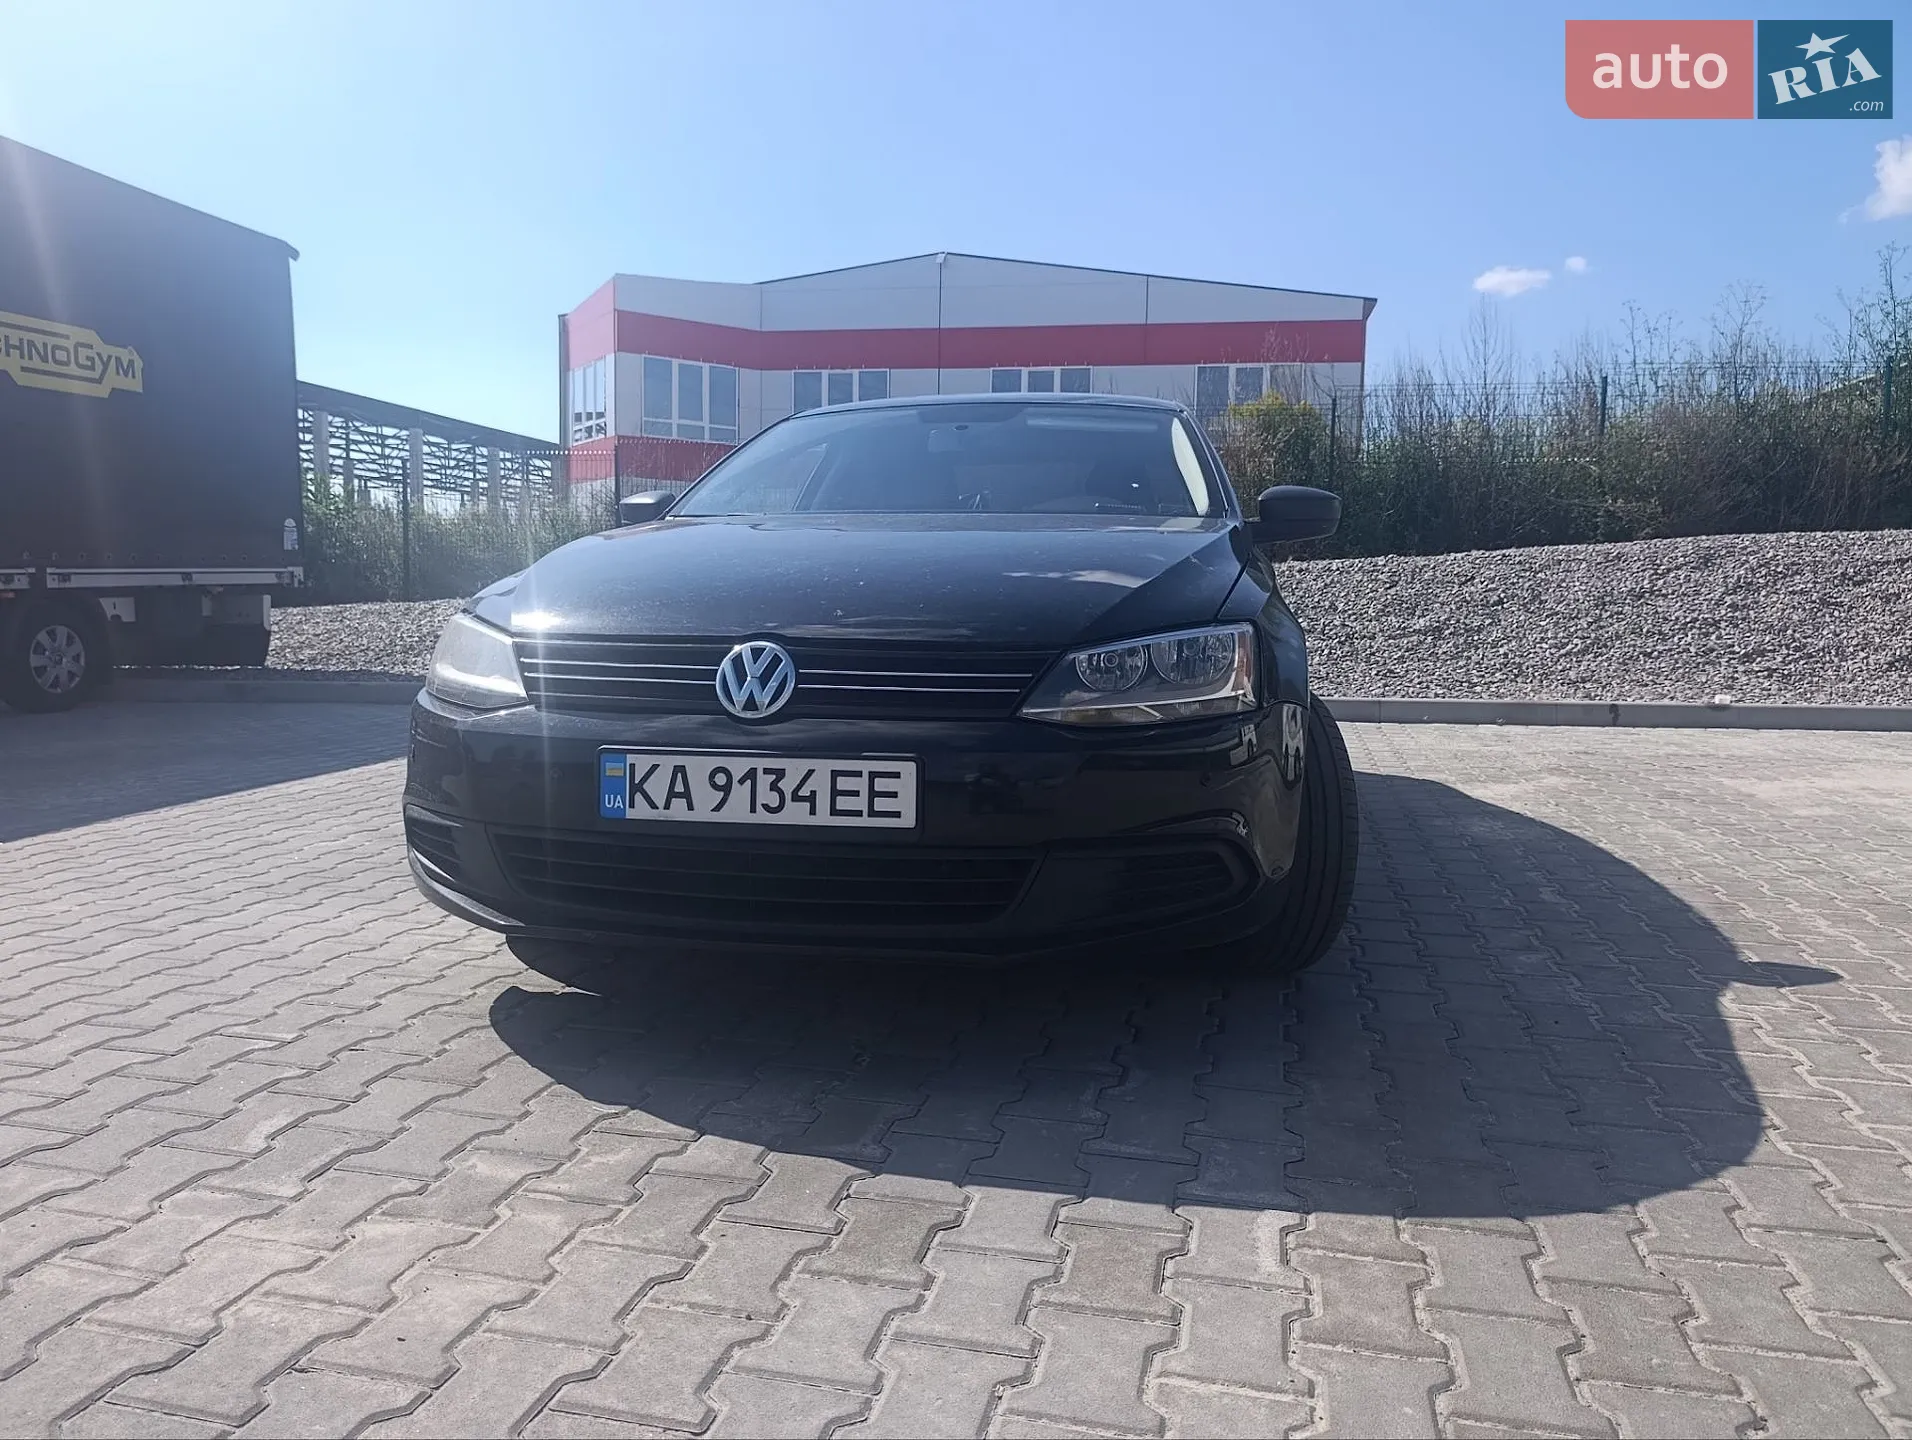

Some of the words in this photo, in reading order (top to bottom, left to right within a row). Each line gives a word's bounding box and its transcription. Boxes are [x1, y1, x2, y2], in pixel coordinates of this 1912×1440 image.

[718, 642, 793, 717] VW
[605, 795, 624, 809] UA
[628, 763, 695, 811] KA
[708, 766, 817, 816] 9134
[829, 769, 902, 818] EE
